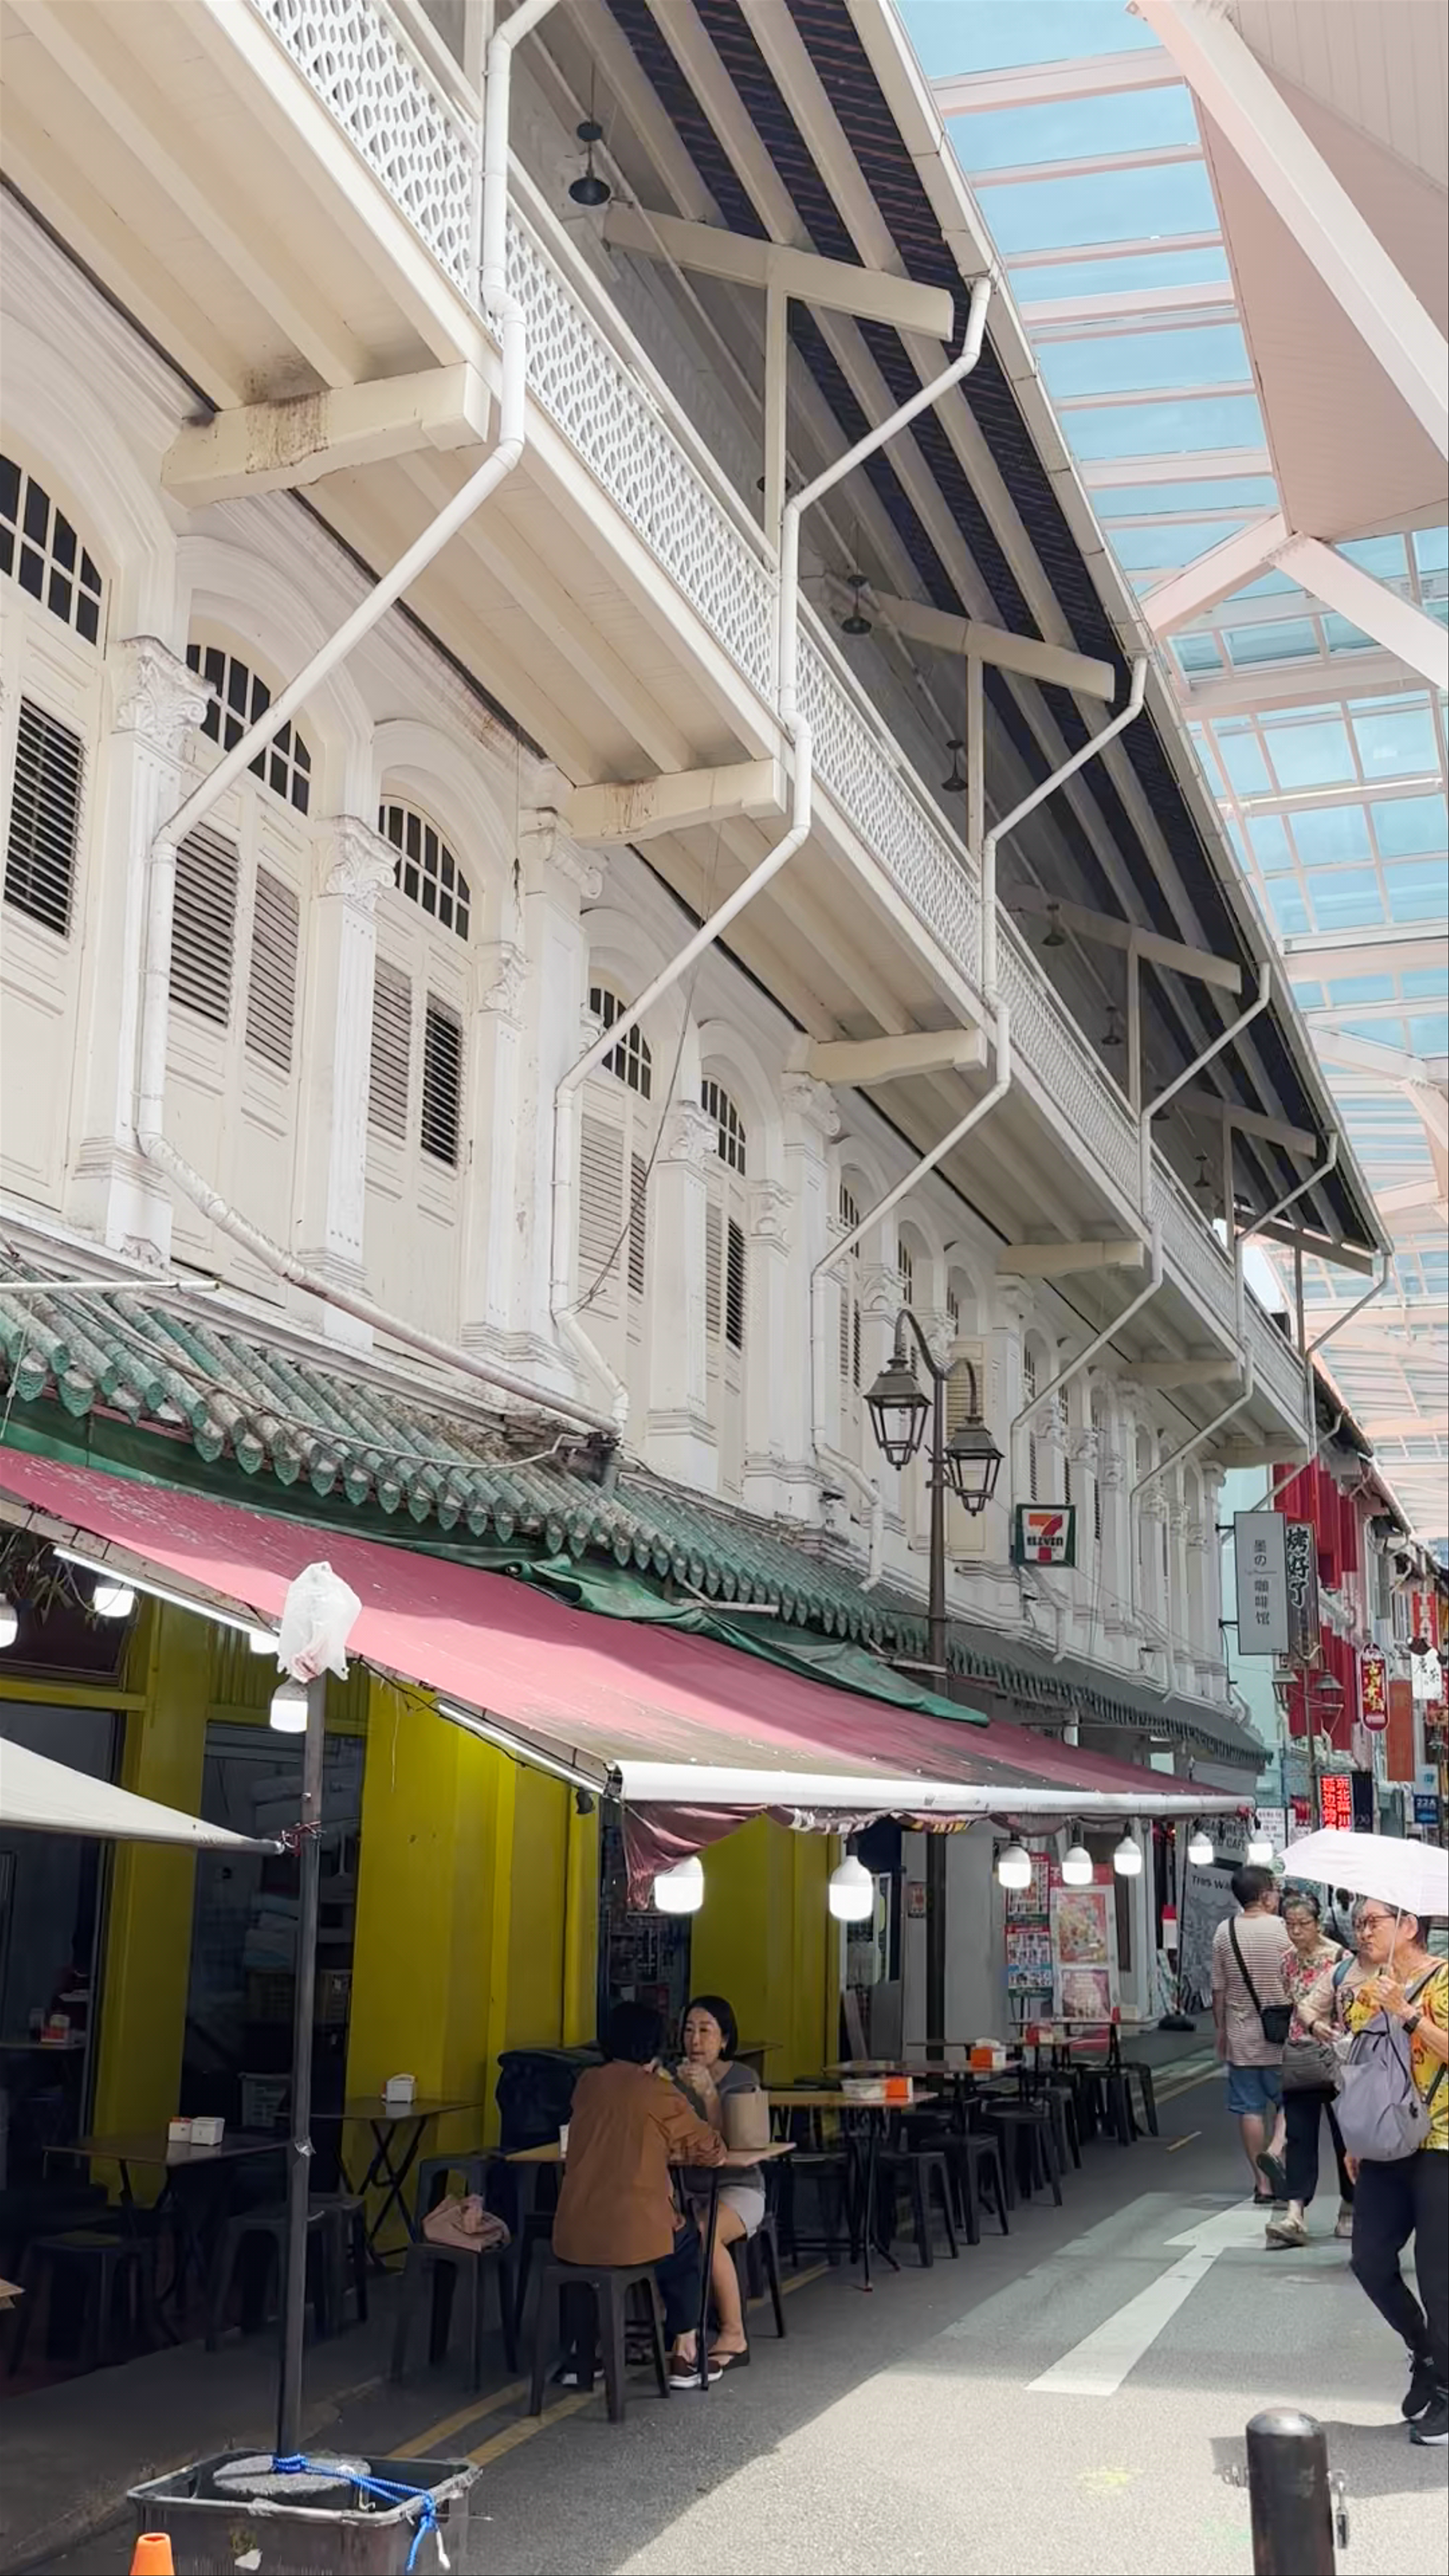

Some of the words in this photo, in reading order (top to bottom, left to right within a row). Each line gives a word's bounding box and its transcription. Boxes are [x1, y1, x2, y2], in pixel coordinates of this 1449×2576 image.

[1287, 1526, 1309, 1607] 烤好了
[1214, 1880, 1232, 1889] WA
